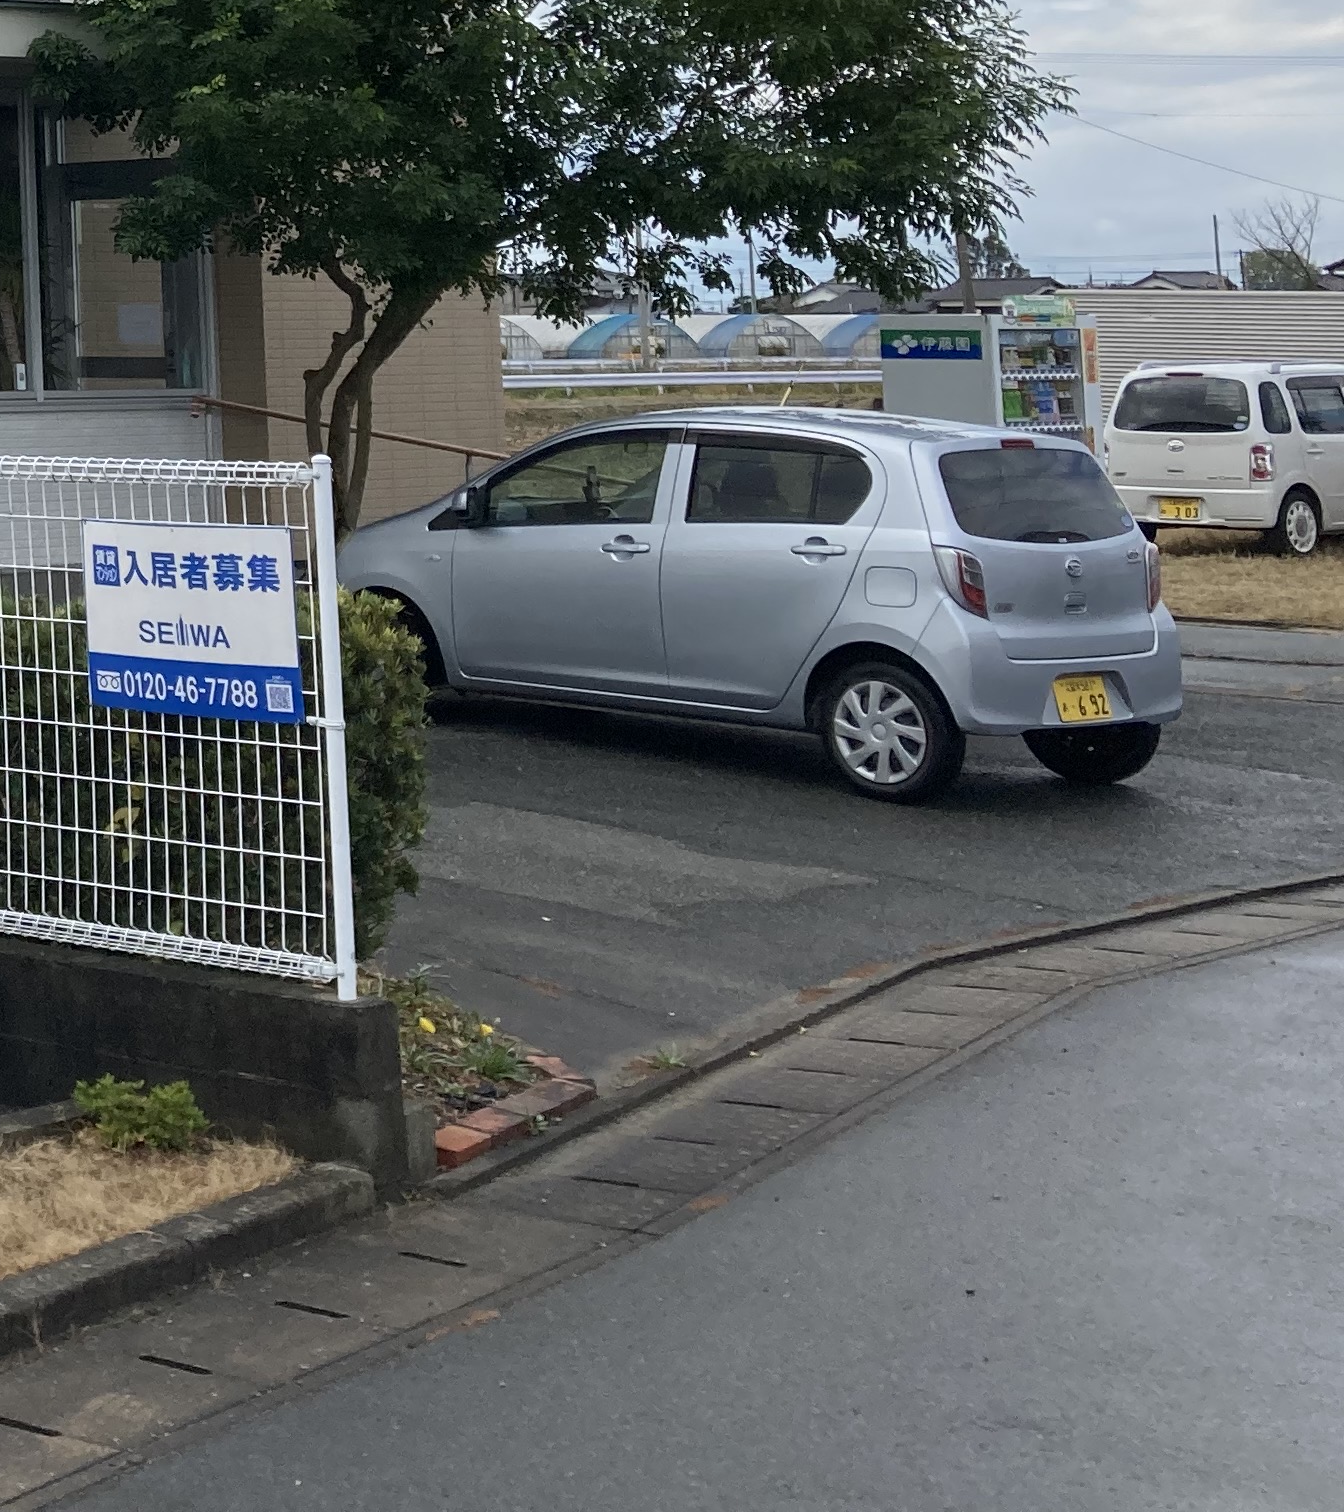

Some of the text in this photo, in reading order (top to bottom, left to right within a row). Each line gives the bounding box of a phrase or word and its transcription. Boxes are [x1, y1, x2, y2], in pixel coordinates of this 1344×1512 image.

[124, 550, 281, 592] 入居者募集
[139, 614, 231, 649] SEIWA
[123, 670, 259, 708] 0120-46-7788
